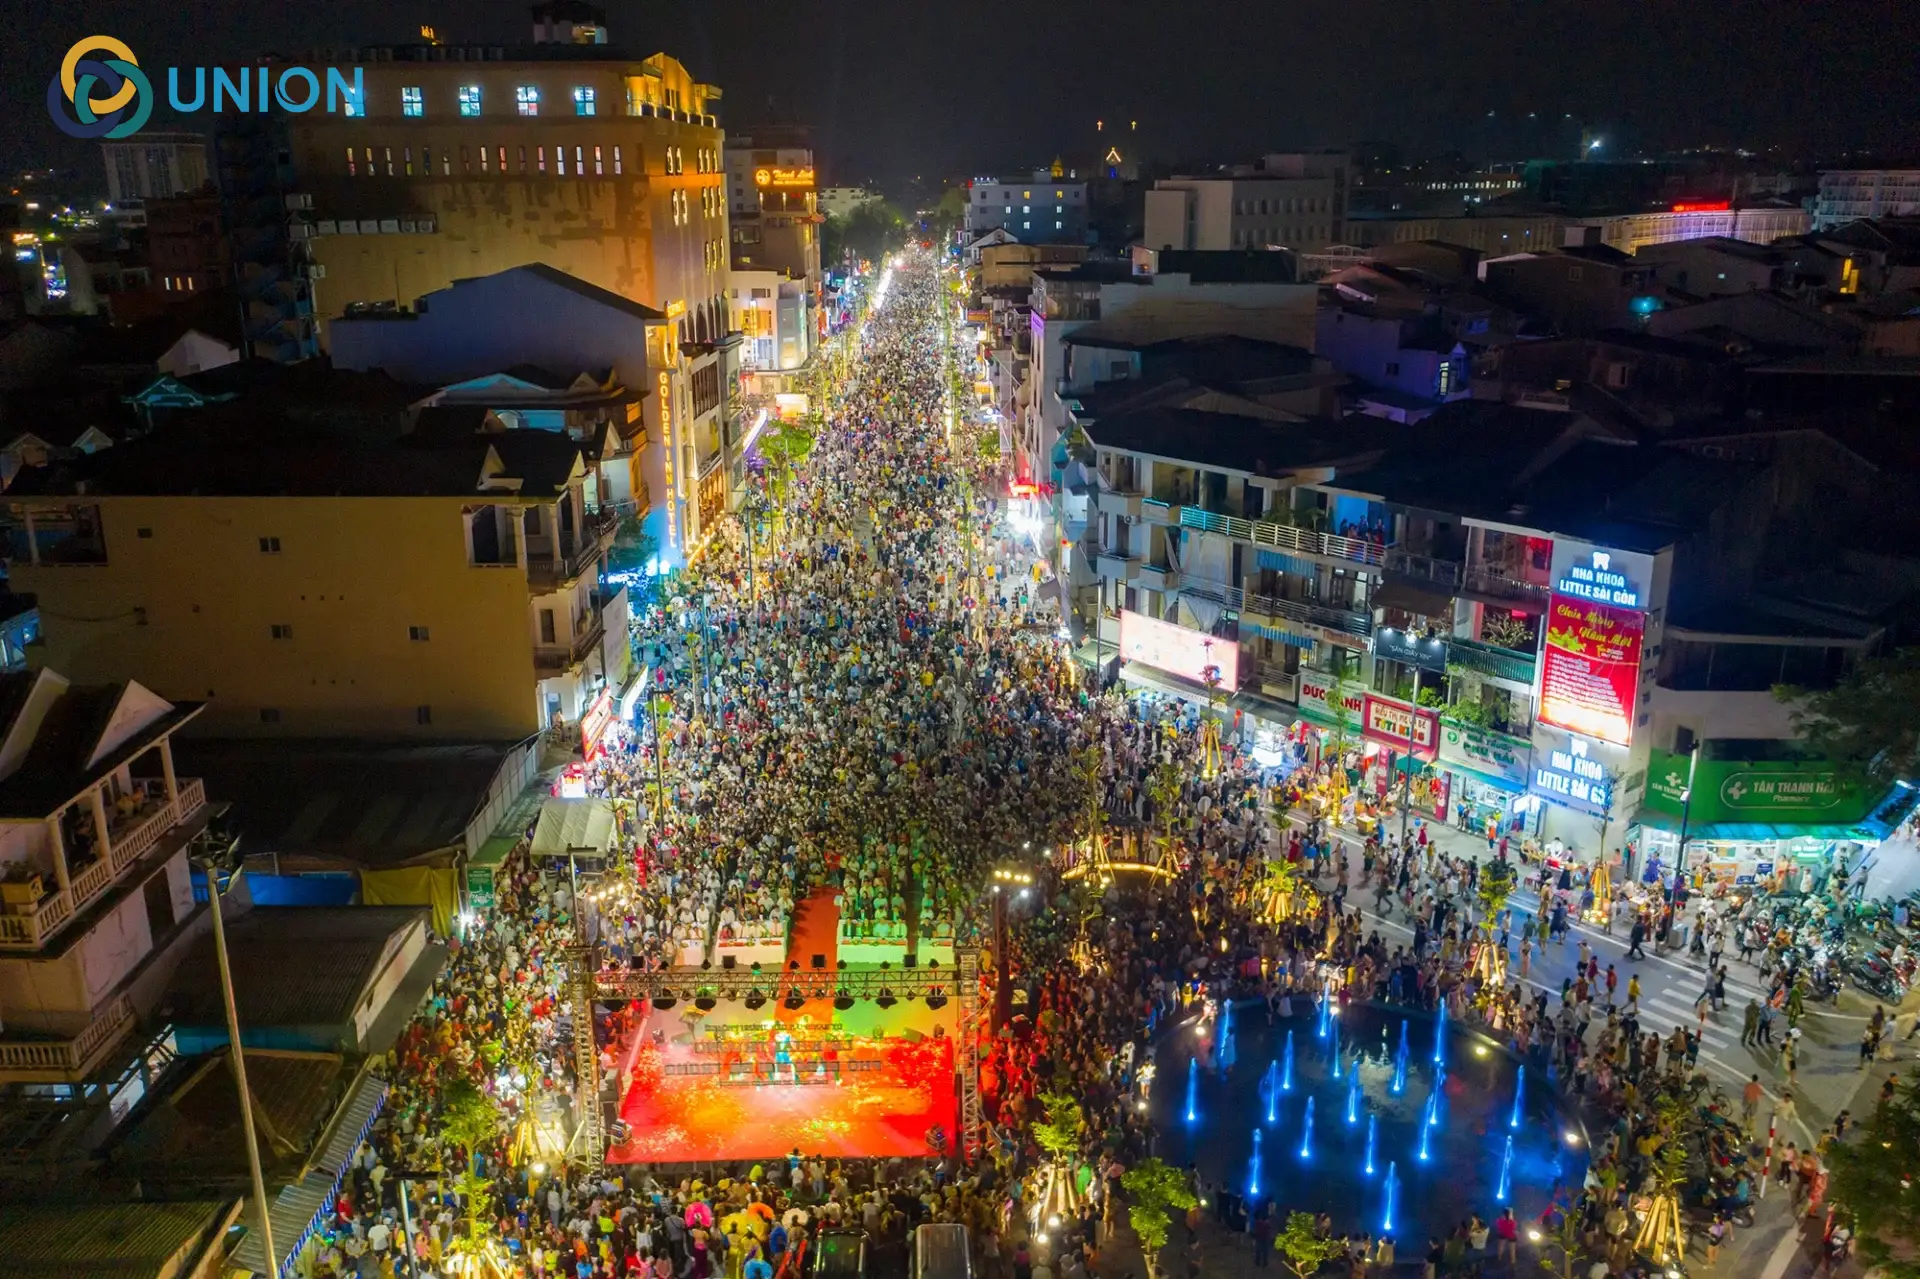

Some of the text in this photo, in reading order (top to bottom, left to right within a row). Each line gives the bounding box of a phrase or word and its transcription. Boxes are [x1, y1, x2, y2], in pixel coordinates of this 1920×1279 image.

[658, 371, 672, 446] GOLDEN
[666, 487, 678, 548] HOTEL
[1572, 566, 1625, 588] NHA KHOA
[1560, 579, 1636, 606] LITTLE SÀI GÒN
[1551, 750, 1603, 781] NHA KHOA
[1536, 768, 1570, 795] LITTLE
[1753, 780, 1774, 793] TÂN
[1777, 781, 1813, 794] THANH
[1773, 794, 1811, 803] Pharmacy
